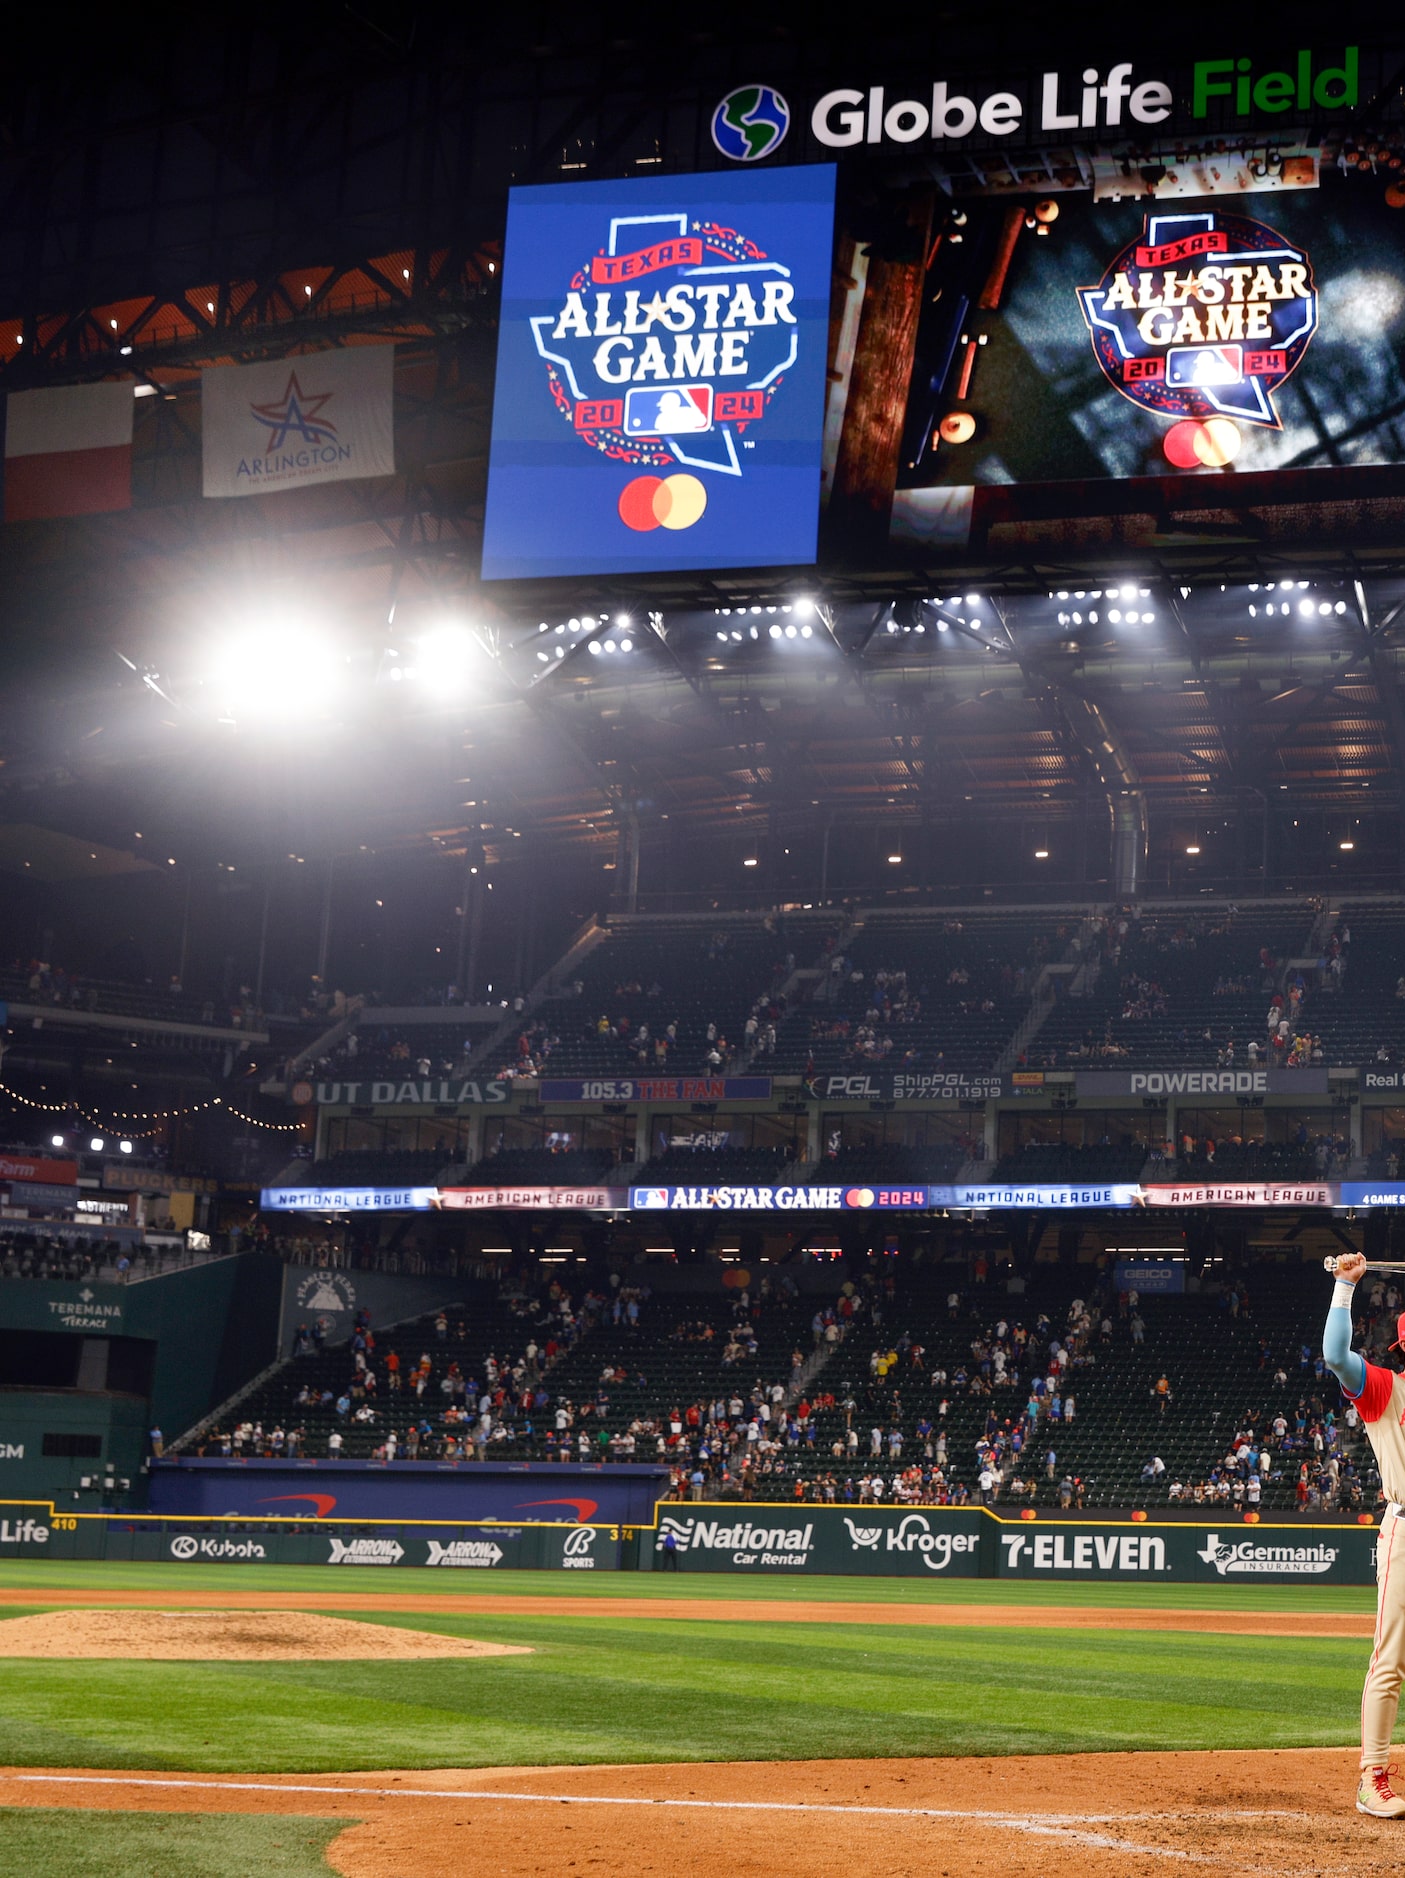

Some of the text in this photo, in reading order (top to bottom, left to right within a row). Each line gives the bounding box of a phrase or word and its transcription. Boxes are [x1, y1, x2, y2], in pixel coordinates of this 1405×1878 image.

[812, 46, 1359, 147] Globe Life Field
[1145, 237, 1218, 263] TEXAS
[601, 242, 692, 281] TEXAS
[1137, 305, 1273, 345] GAME
[593, 332, 751, 383] GAME
[1128, 351, 1281, 379] 20 24
[583, 396, 755, 423] 20 24
[236, 444, 351, 477] ARLINGTON
[826, 1076, 880, 1095] PGL
[893, 1074, 1001, 1088] ShipPGL.com
[1131, 1072, 1268, 1093] POWERADE
[1366, 1072, 1399, 1087] Real
[317, 1081, 506, 1103] UT DALLAS
[582, 1080, 725, 1100] 105.3 THE FAN
[893, 1088, 1001, 1099] 877.701.1919
[106, 1171, 218, 1192] PLUCKERS
[279, 1194, 411, 1206] NATIONAL LEAGUE
[465, 1194, 605, 1205] AMERICAN LEAGUE
[774, 1187, 842, 1207] GAME
[879, 1191, 924, 1205] 2024
[966, 1191, 1111, 1204] NATIONAL LEAGUE
[1172, 1190, 1326, 1202] AMERICAN LEAGUE
[1363, 1195, 1369, 1204] 4
[1370, 1195, 1398, 1204] GAME
[1124, 1269, 1171, 1279] GEICO
[48, 1301, 121, 1317] TEREMANA
[61, 1315, 107, 1328] TERRACE
[1, 1519, 49, 1542] Life
[51, 1519, 77, 1531] 410
[692, 1521, 813, 1551] National
[887, 1514, 980, 1570] Kroger
[201, 1539, 265, 1558] Kubota
[349, 1540, 393, 1556] ARROW
[448, 1541, 493, 1557] ARROW
[1001, 1534, 1165, 1571] 7-ELEVEN
[1239, 1542, 1336, 1562] Germania
[563, 1557, 595, 1568] SPORTS
[733, 1552, 807, 1565] Car Rental
[1244, 1563, 1318, 1572] INSURANCE
